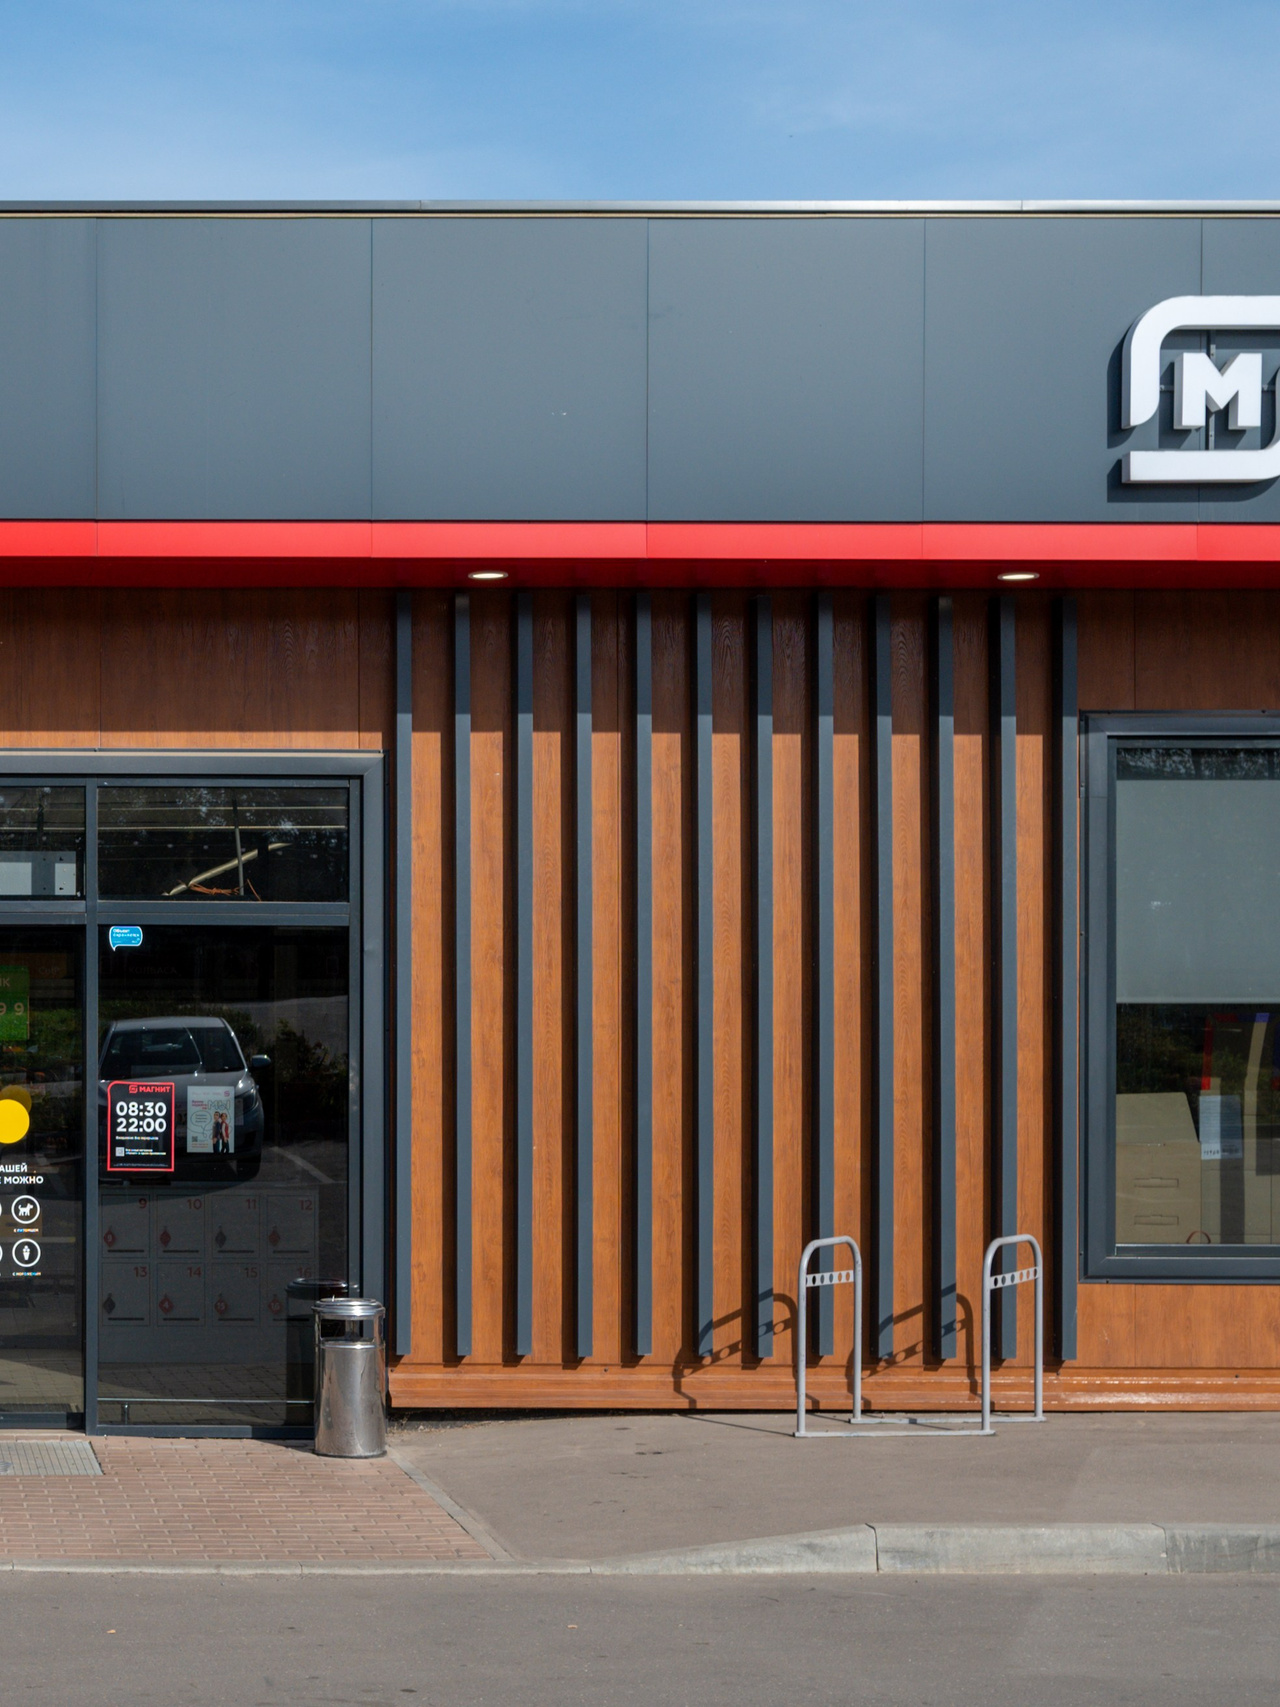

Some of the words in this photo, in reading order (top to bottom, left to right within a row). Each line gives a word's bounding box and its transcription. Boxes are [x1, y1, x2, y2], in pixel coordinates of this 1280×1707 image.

[116, 1101, 167, 1117] 08:30
[116, 1117, 167, 1132] 22:00
[3, 1175, 44, 1185] МОЖНО
[138, 1199, 147, 1209] 9
[187, 1199, 202, 1210] 10
[246, 1199, 257, 1210] 11
[299, 1200, 313, 1211] 12
[133, 1267, 147, 1278] 13
[187, 1267, 202, 1278] 14
[244, 1267, 258, 1278] 15
[298, 1267, 312, 1278] 16
